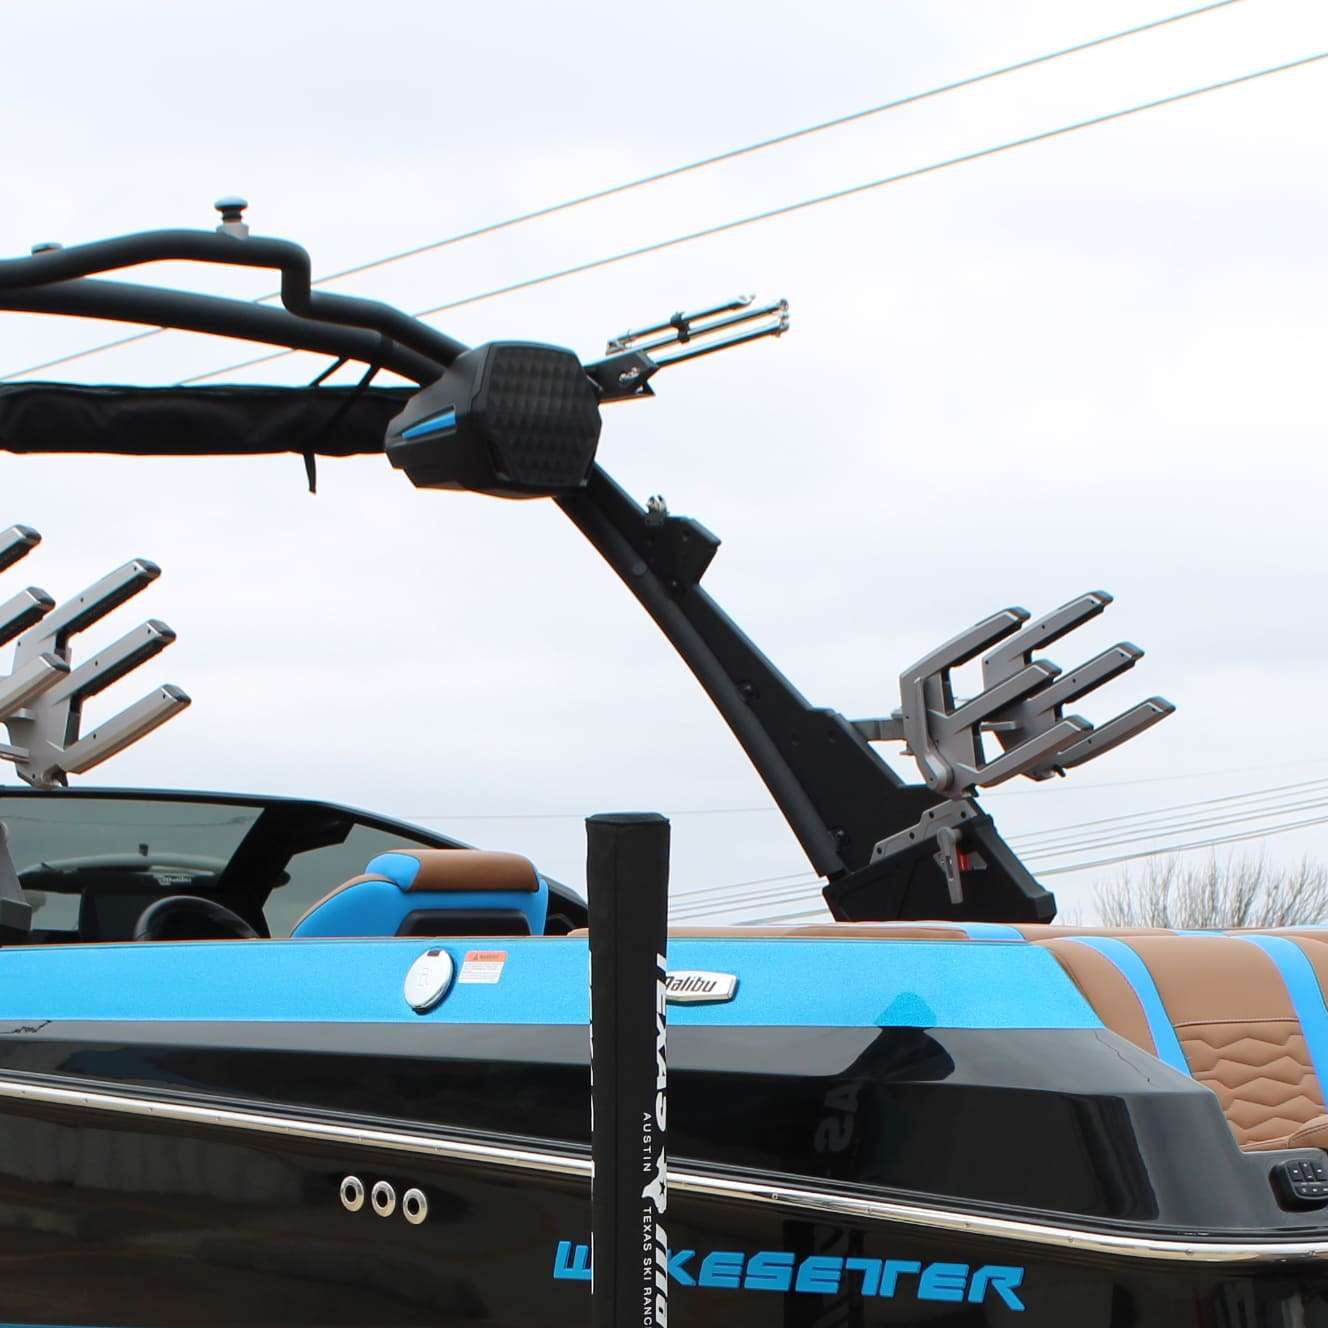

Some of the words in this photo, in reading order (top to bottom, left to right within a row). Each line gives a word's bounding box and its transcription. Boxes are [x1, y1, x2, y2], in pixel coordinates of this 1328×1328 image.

[642, 1112, 652, 1173] AUSTIN
[642, 1207, 652, 1252] TEXAS
[553, 1240, 1026, 1312] WKESETTER
[642, 1257, 652, 1281] SKI
